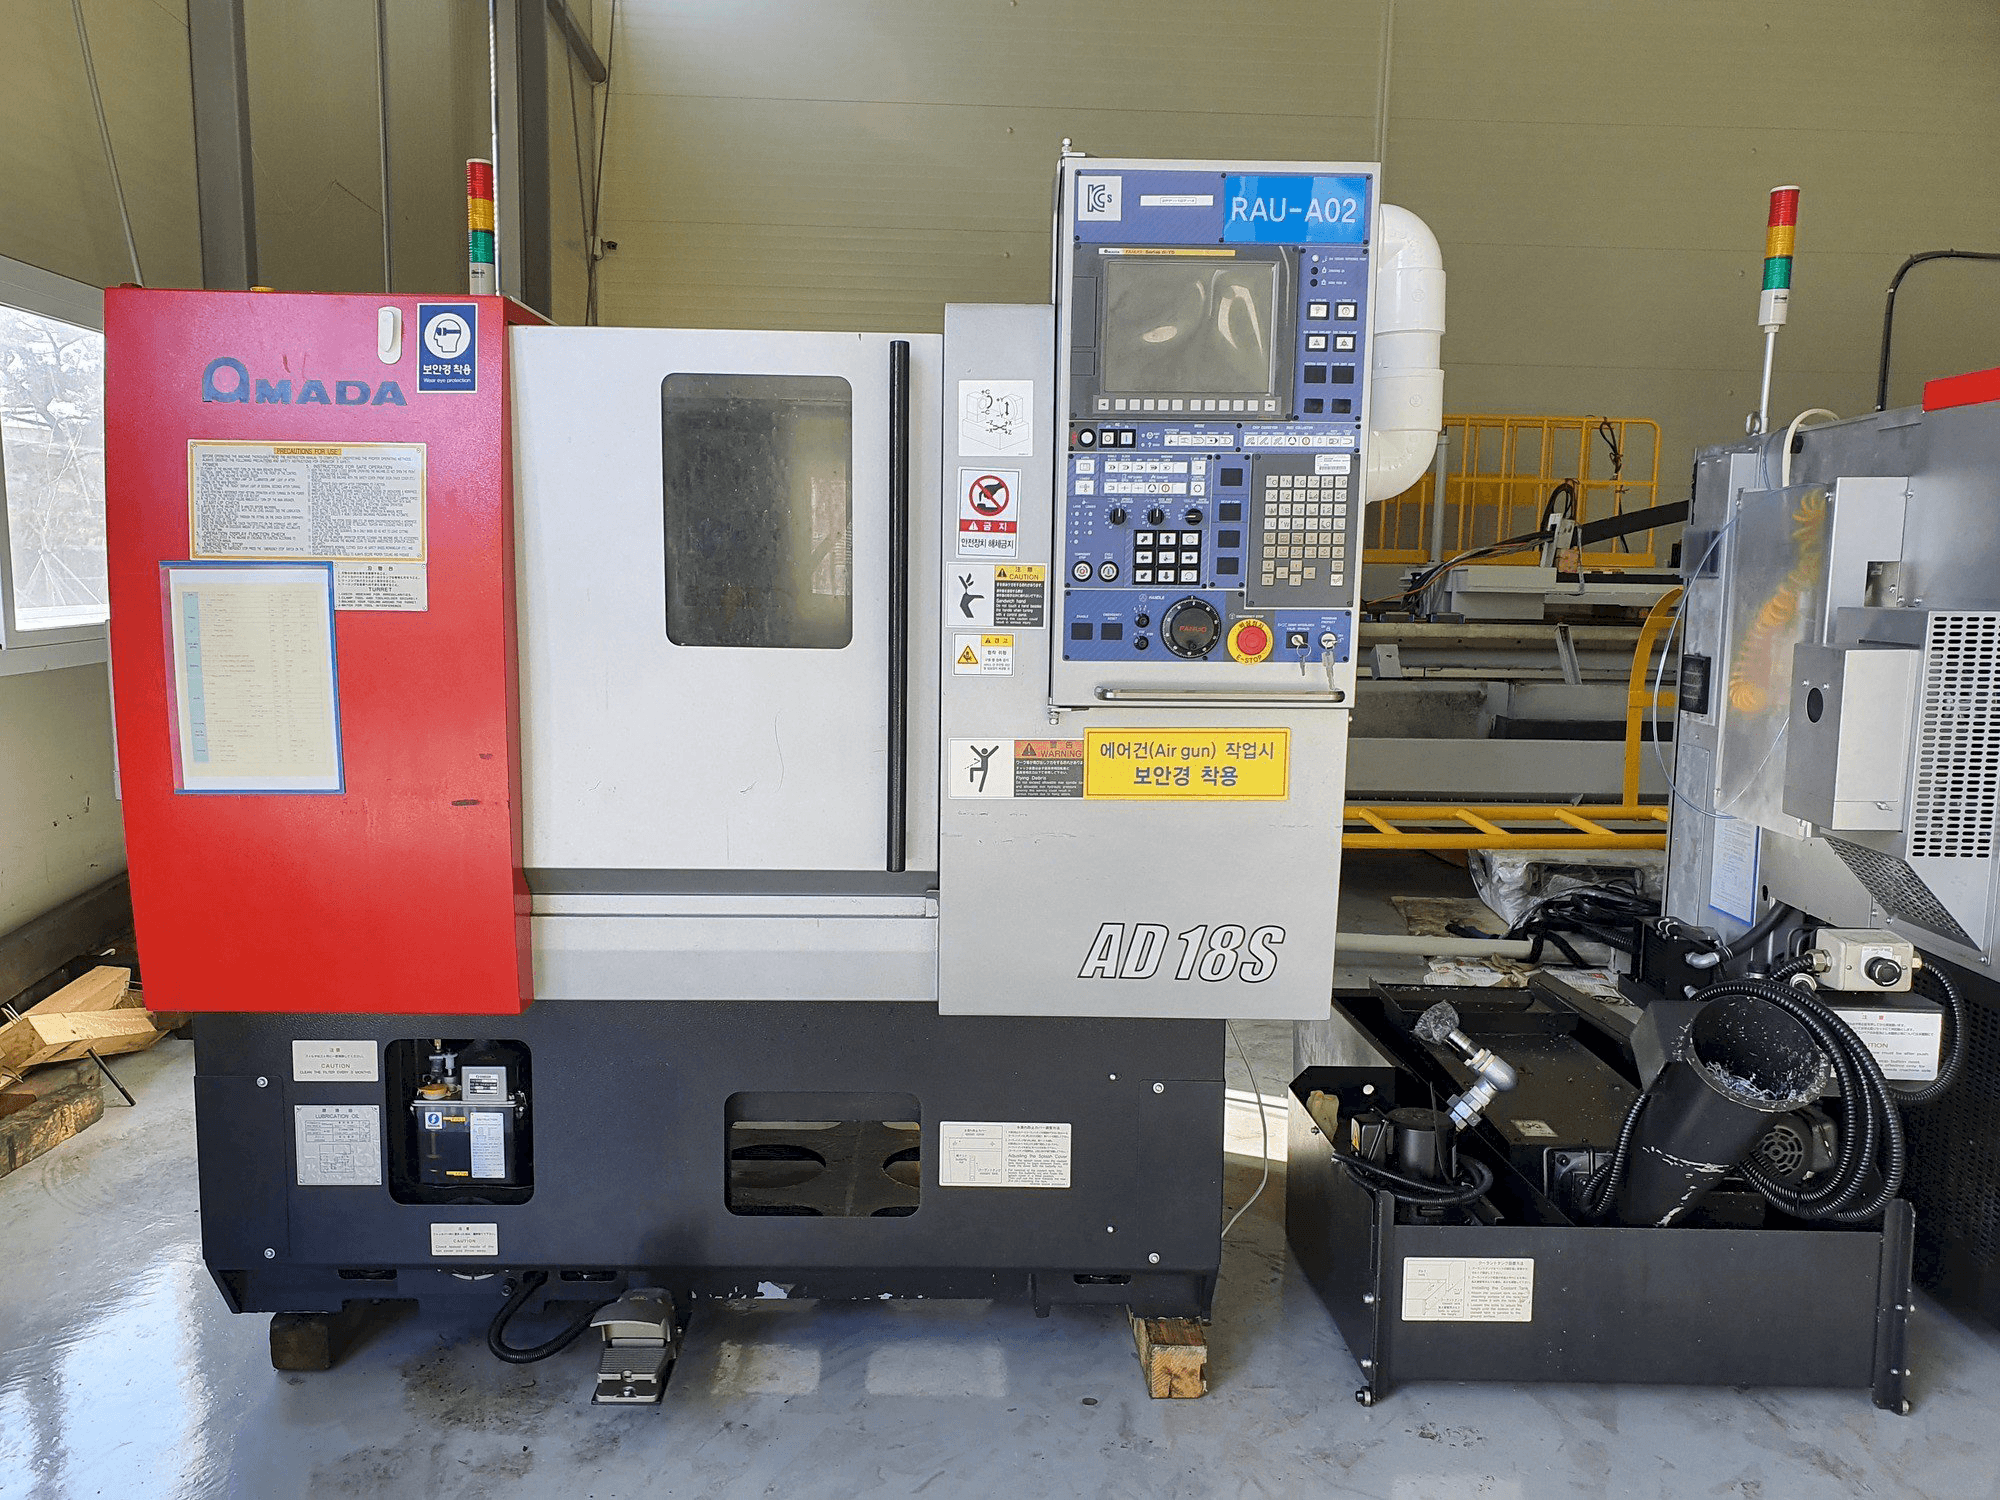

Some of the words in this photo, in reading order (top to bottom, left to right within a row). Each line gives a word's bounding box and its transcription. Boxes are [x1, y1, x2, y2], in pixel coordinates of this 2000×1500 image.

[1231, 196, 1358, 223] RAU-A02
[422, 364, 452, 376] 보안경
[452, 364, 472, 376] 착용
[202, 356, 408, 406] AMADA
[446, 377, 472, 385] protection
[276, 447, 312, 455] PRECAUTIONS
[314, 447, 328, 455] FOR
[328, 447, 339, 455] USE
[961, 537, 987, 549] 안전장치
[987, 538, 1014, 549] 해체금지
[1009, 573, 1039, 581] CAUTION
[1235, 654, 1263, 664] E-STOP
[1040, 750, 1082, 758] WARNING
[1100, 741, 1178, 761] 에어건(Air
[1180, 741, 1218, 761] gun)
[1225, 741, 1275, 761] 작업시
[1133, 766, 1191, 787] 보안경
[1199, 766, 1239, 787] 착용
[1077, 922, 1170, 979] AD
[1174, 924, 1287, 984] 18S
